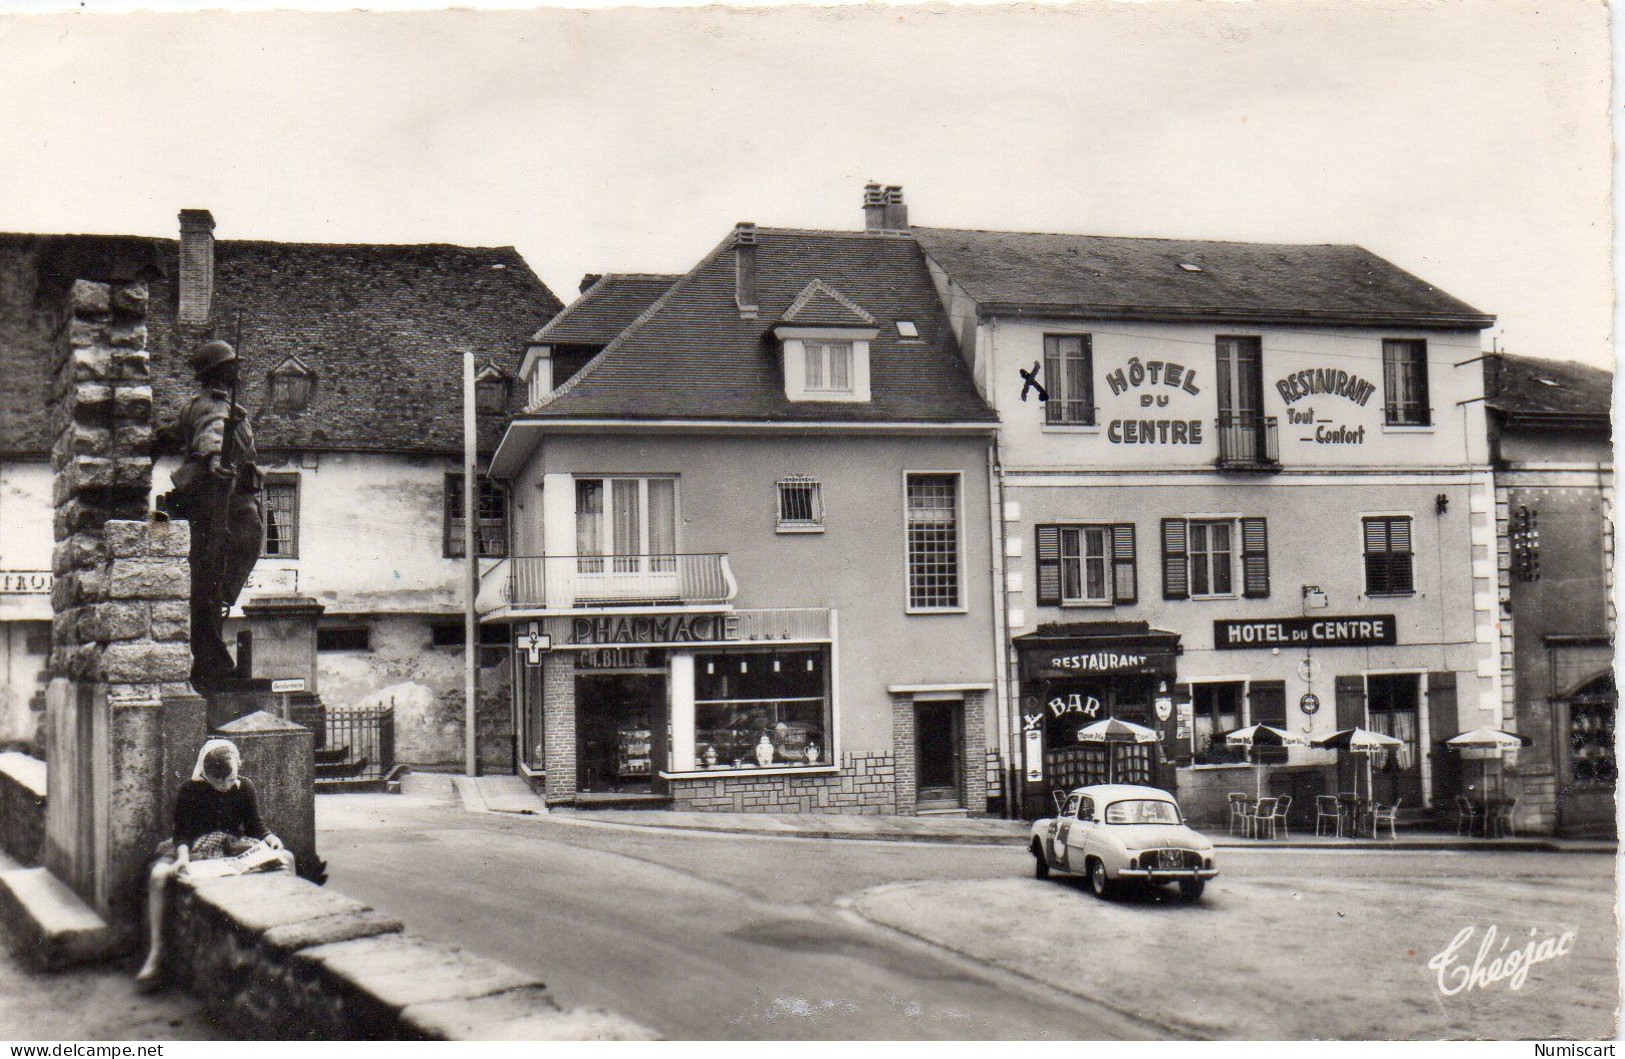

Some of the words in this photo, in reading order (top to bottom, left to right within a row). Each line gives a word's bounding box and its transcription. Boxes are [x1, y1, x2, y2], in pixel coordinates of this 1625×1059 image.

[1105, 356, 1200, 396] HÔTEL
[1275, 367, 1376, 407] RESTAURANT
[1140, 394, 1169, 407] DU
[1286, 407, 1314, 425] Tout
[1107, 419, 1203, 445] CENTRE
[1315, 424, 1365, 445] Confort
[573, 615, 740, 643] PHARMACIE
[1228, 623, 1288, 643] HOTEL
[1292, 628, 1308, 641] DU
[1312, 620, 1384, 640] CENTRE
[1051, 652, 1148, 671] RESTAURANT
[1048, 693, 1101, 718] BAR
